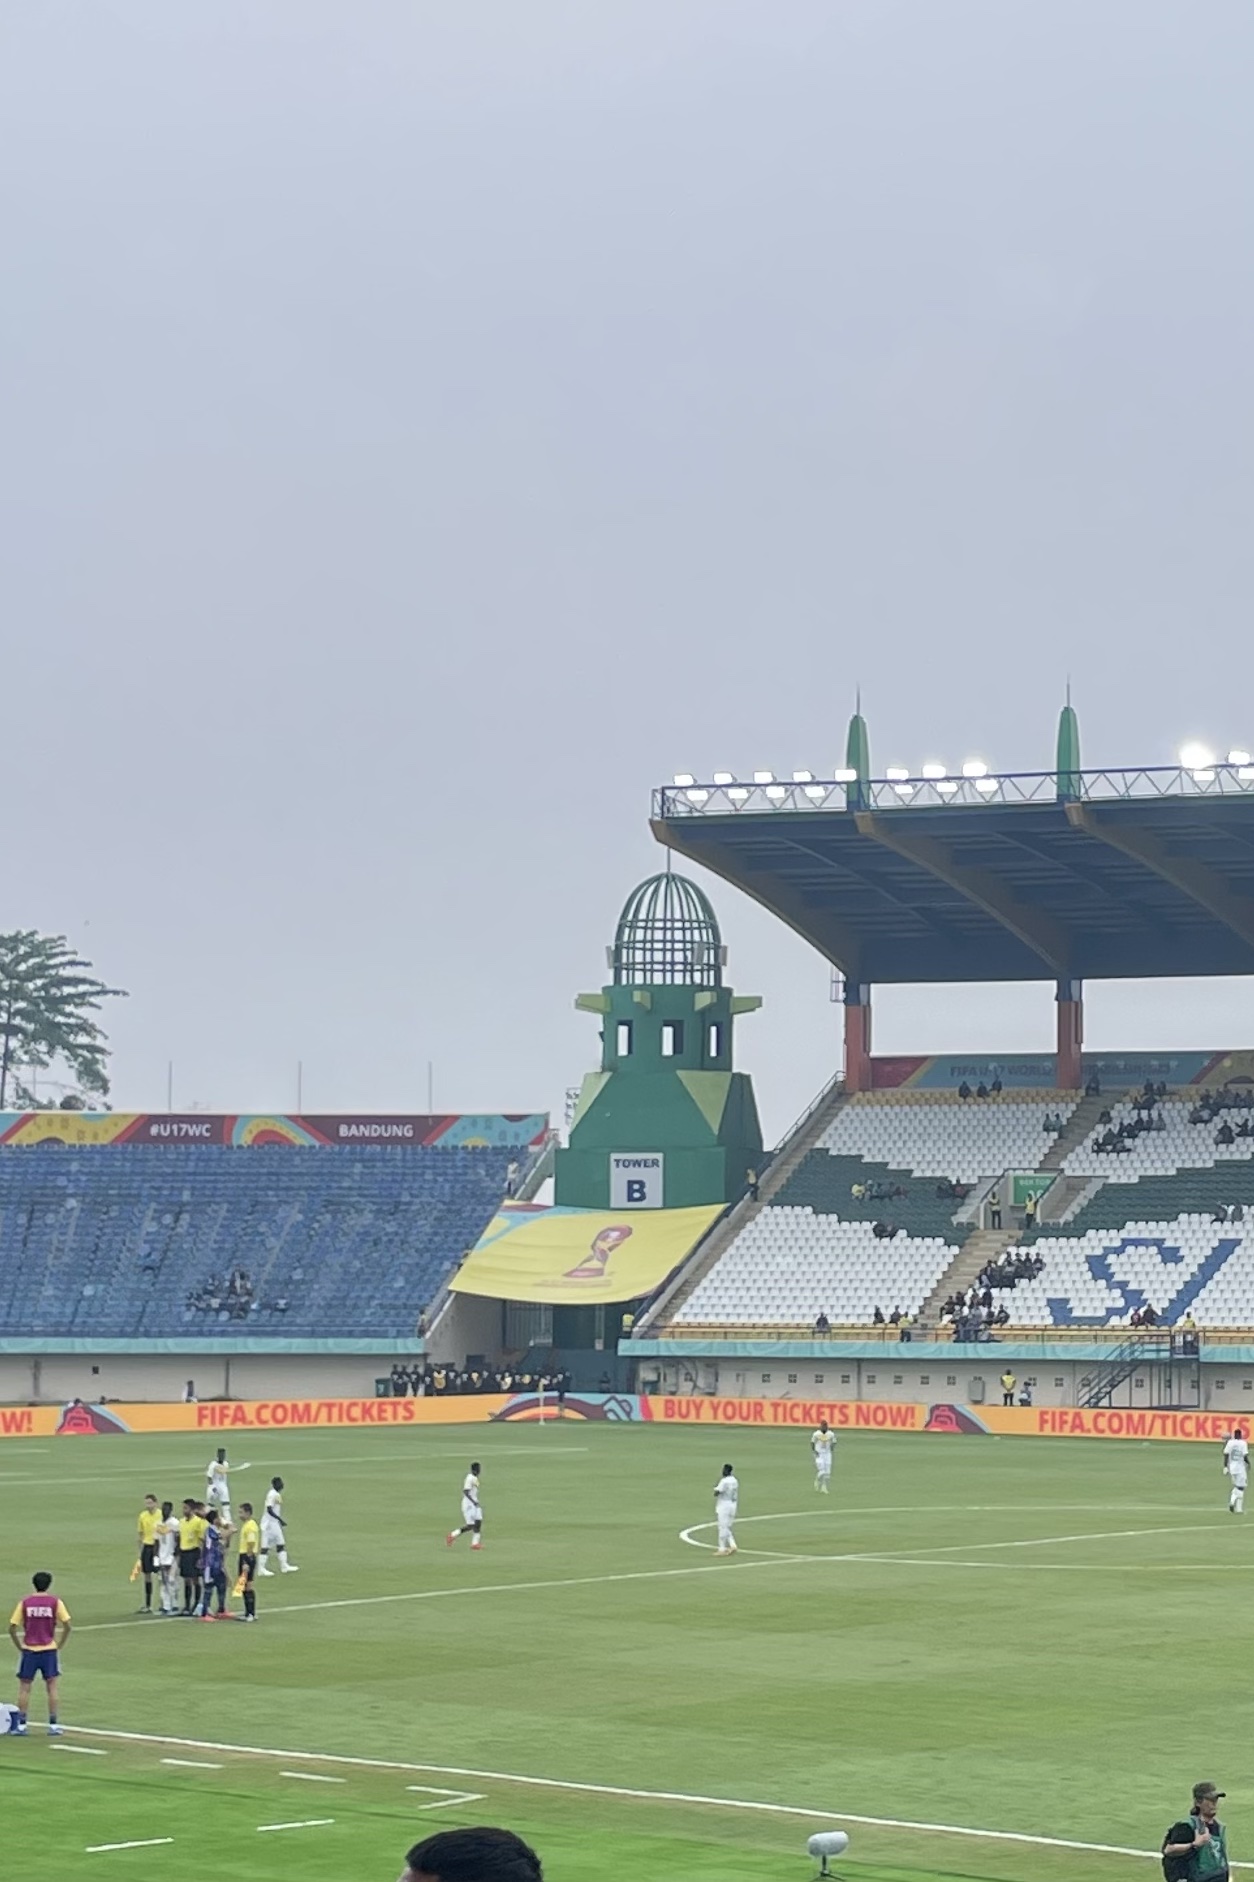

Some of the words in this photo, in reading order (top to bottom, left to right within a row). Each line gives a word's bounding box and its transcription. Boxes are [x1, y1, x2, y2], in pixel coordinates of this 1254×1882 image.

[150, 1123, 212, 1138] #U17WC
[338, 1123, 414, 1138] BANDUNG
[613, 1158, 660, 1169] TOWER
[626, 1179, 647, 1203] B
[196, 1400, 415, 1427] FIFA.COM/TICKETS
[663, 1398, 709, 1421] BUY
[709, 1399, 766, 1422] YOUR
[770, 1402, 849, 1425] TICKETS
[855, 1404, 916, 1428] NOW!
[1038, 1410, 1251, 1440] FIFA.COM/TICKETS
[26, 1606, 53, 1618] FIFA
